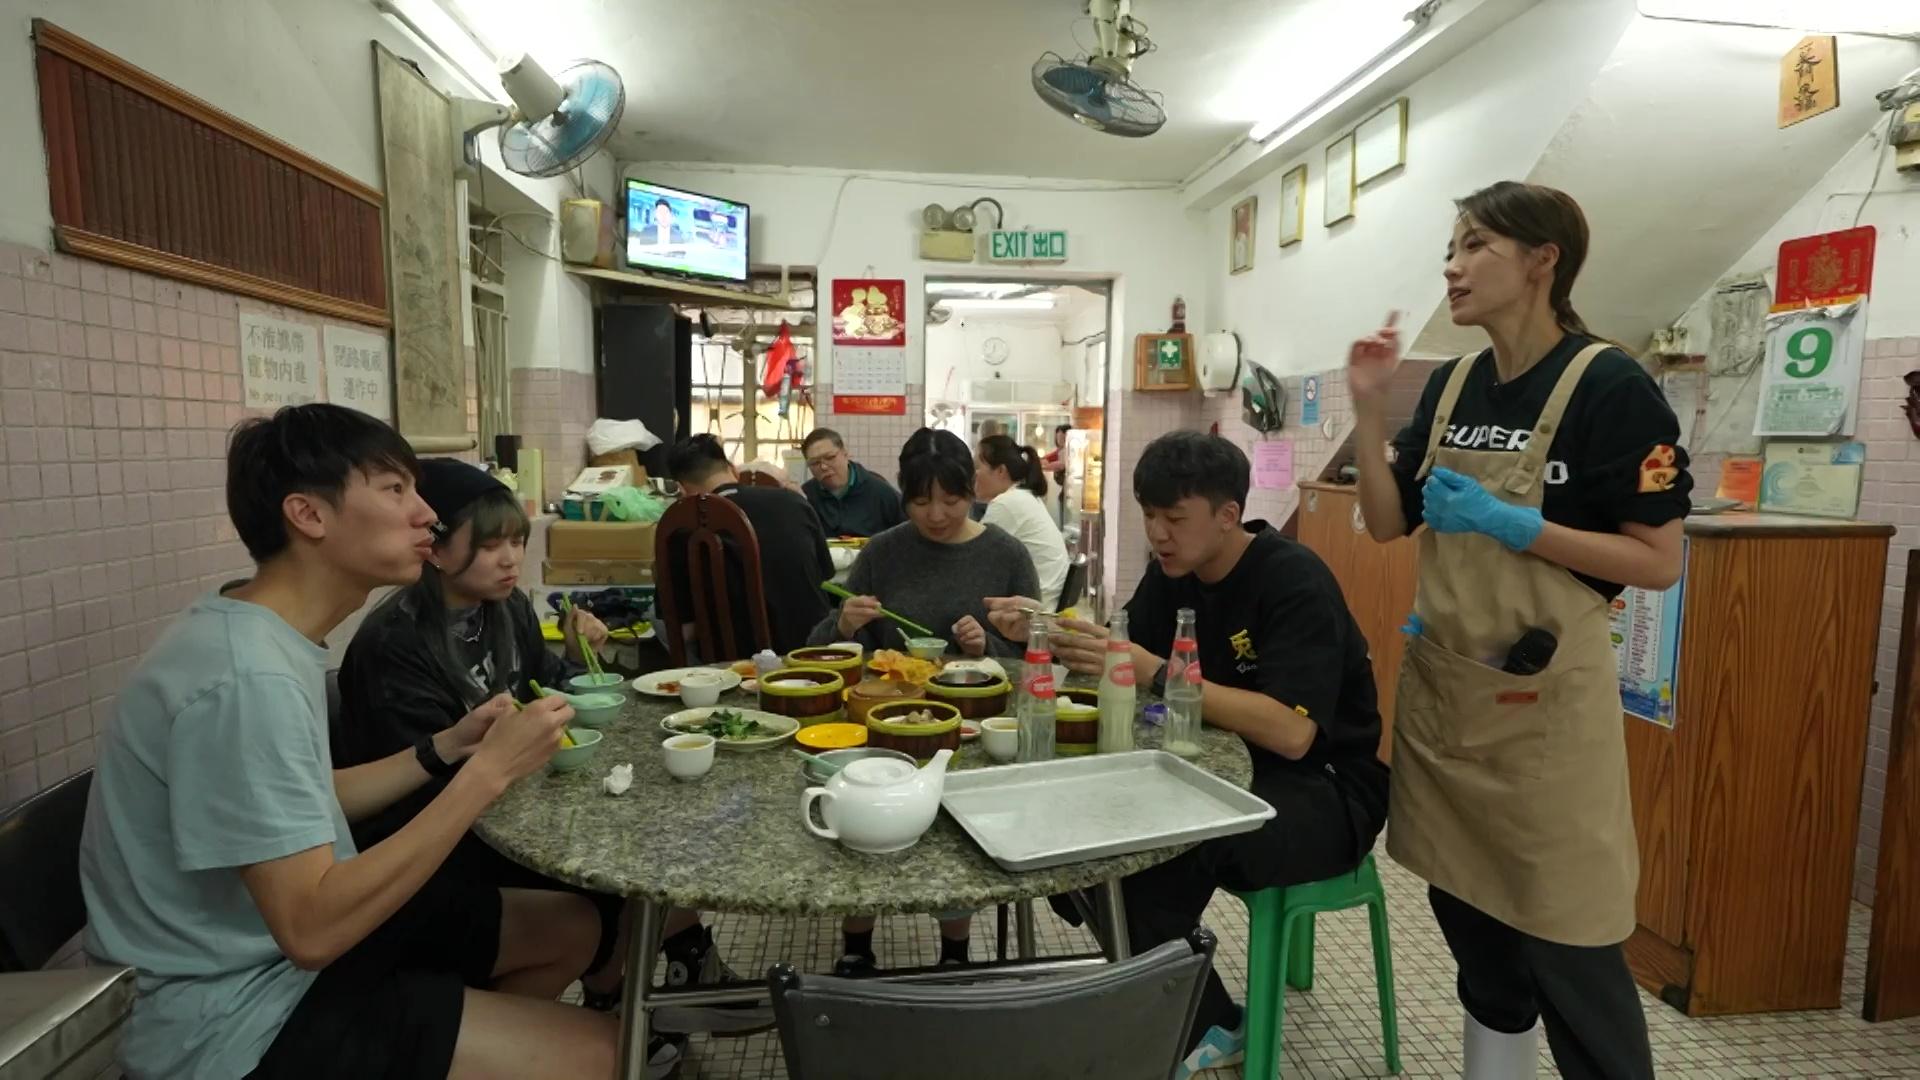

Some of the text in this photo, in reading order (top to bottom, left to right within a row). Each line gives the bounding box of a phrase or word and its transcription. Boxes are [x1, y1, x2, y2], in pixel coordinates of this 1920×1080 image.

[992, 230, 1066, 258] EXIT 出口
[1784, 327, 1833, 378] 9
